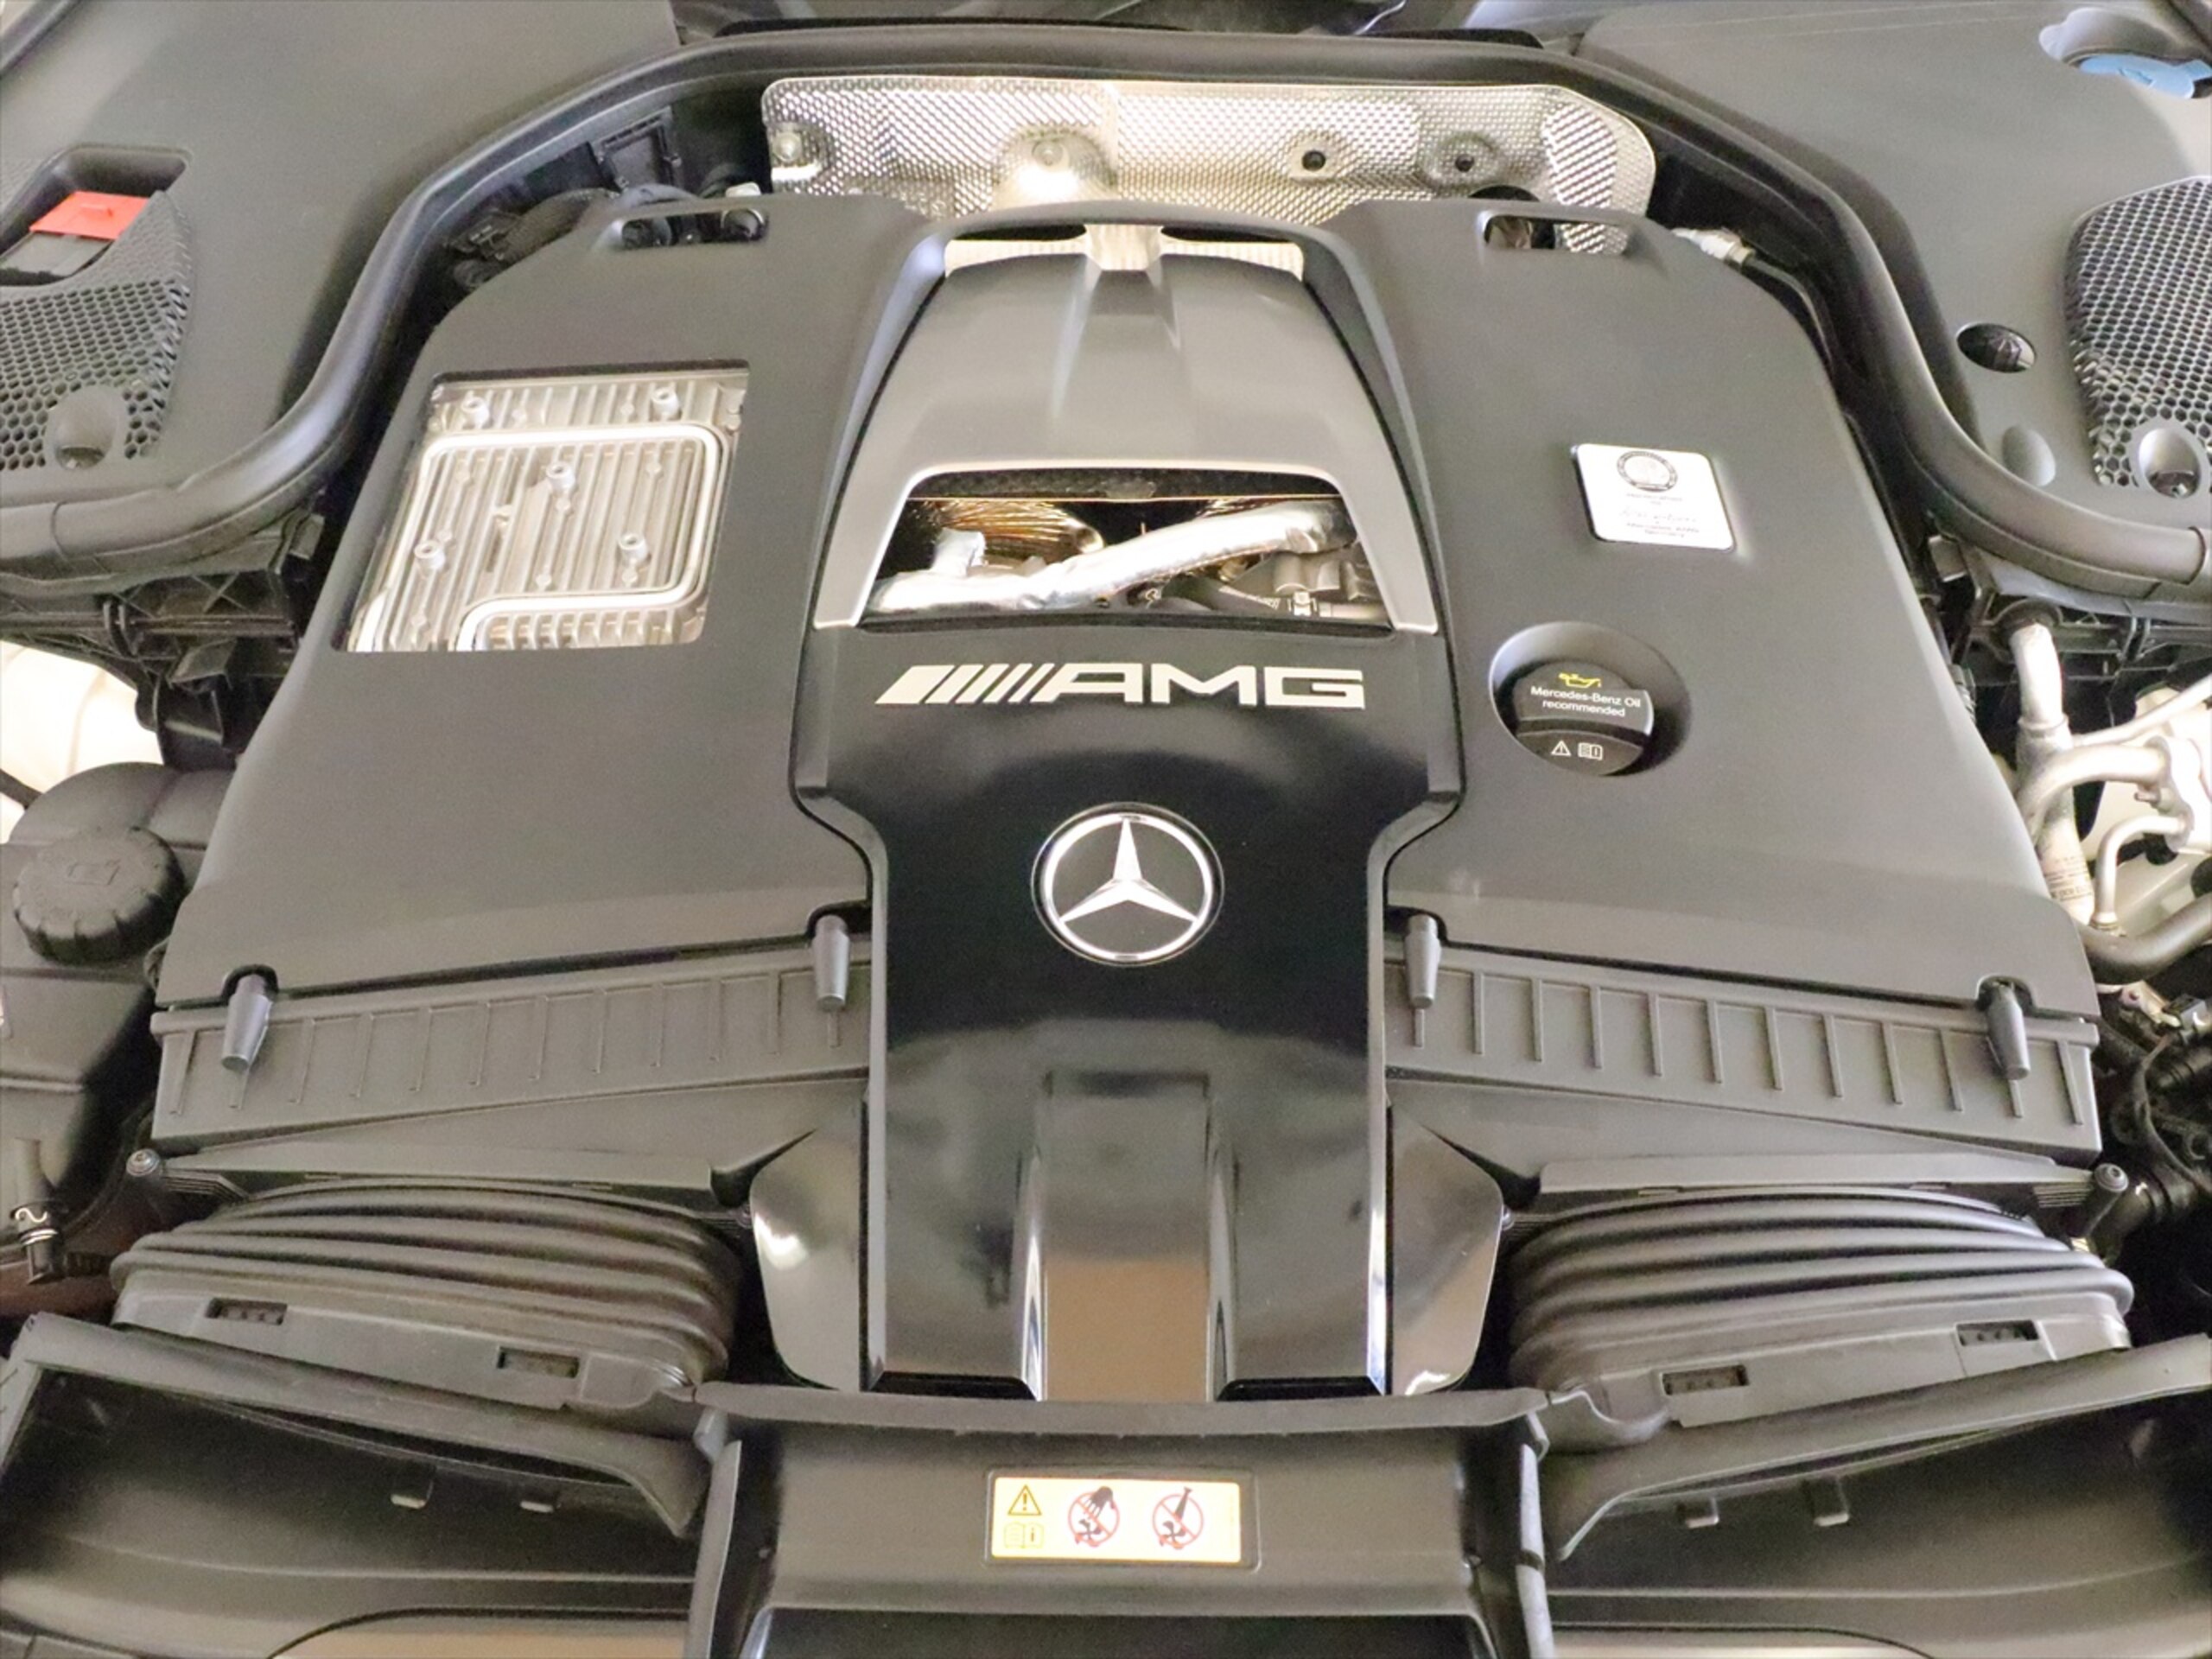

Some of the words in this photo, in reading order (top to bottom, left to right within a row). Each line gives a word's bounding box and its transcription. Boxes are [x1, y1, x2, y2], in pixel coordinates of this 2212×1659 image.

[1029, 663, 1366, 709] AMG
[1530, 685, 1622, 705] Mercedes-Benz
[1624, 696, 1641, 708] Oil
[1541, 699, 1626, 717] recommended
